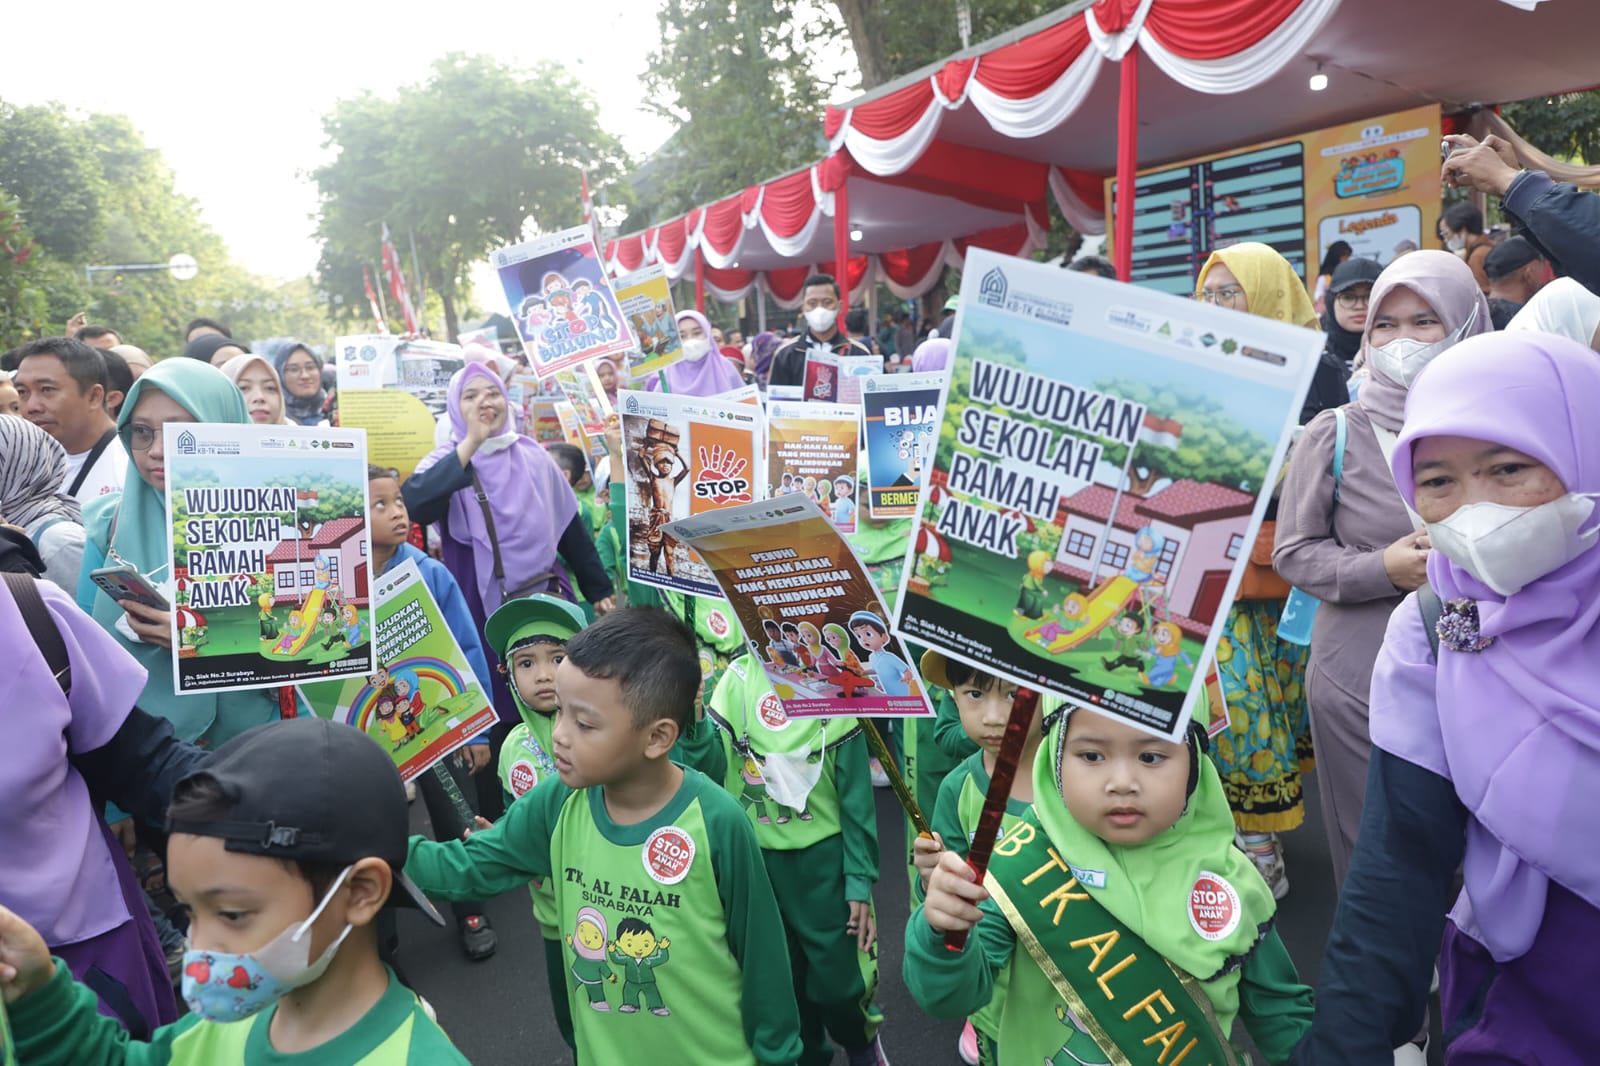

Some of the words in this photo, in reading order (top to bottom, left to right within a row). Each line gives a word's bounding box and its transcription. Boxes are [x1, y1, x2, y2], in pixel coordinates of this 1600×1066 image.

[1339, 213, 1398, 235] Legenda
[545, 315, 599, 343] STOP
[540, 328, 617, 362] BULLYING
[973, 361, 1143, 443] WUJUDKAN
[960, 409, 1100, 482] SEKOLAH
[695, 480, 747, 496] STOP
[950, 454, 1059, 519] RAMAH
[186, 488, 296, 513] WUJUDKAN
[187, 518, 280, 544] SEKOLAH
[939, 501, 1021, 555] ANAK
[189, 549, 265, 575] RAMAH
[750, 548, 797, 562] PENUHI
[734, 581, 766, 593] YANG
[766, 570, 852, 589] MEMERLUKAN
[736, 563, 794, 579] HAK-HAK
[794, 558, 832, 571] ANAK
[190, 581, 248, 607] ANAK
[752, 586, 846, 605] PERLINDUNGAN
[376, 600, 419, 633] UJUDKAN
[779, 603, 830, 617] KHUSUS
[382, 647, 401, 664] HAK
[403, 630, 427, 650] ANAK
[937, 626, 956, 639] No.2
[957, 633, 993, 653] Surabaya
[513, 769, 533, 782] STOP
[655, 837, 689, 860] STOP
[654, 855, 679, 870] ANAK
[565, 868, 586, 888] TK.
[592, 878, 613, 896] AL
[620, 885, 681, 908] FALAH
[1193, 890, 1227, 905] STOP
[582, 890, 654, 917] SURABAYA
[1200, 910, 1224, 919] ANAK
[1022, 847, 1090, 926] TK
[1069, 929, 1137, 1000] AL
